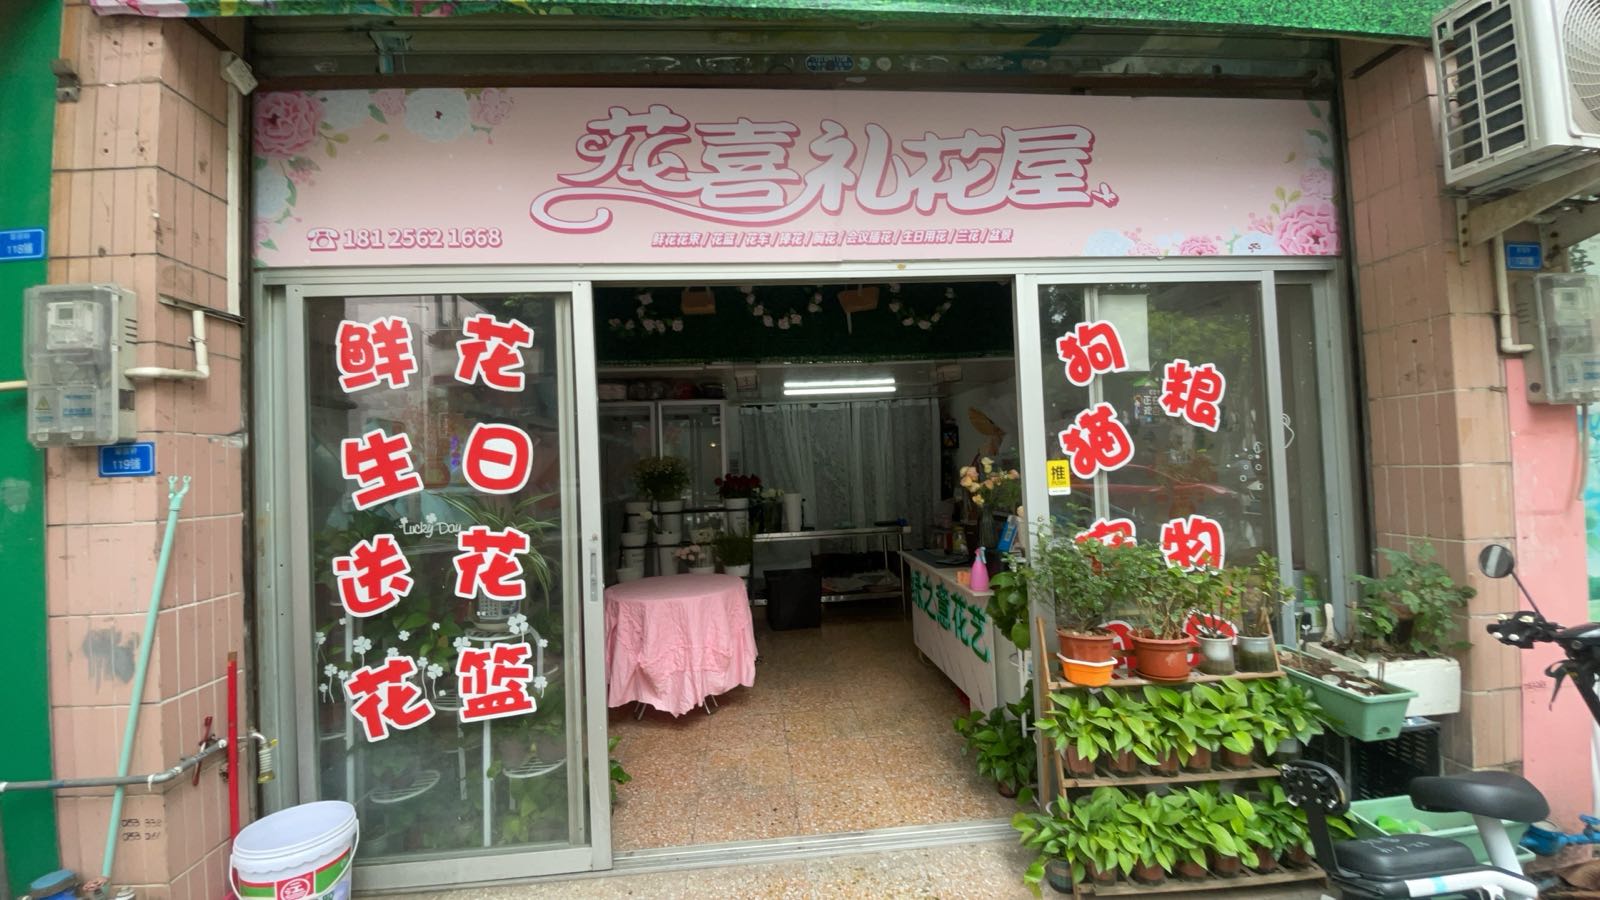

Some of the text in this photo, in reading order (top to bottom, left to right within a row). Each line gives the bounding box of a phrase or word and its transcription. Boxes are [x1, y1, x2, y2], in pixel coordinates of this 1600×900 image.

[531, 104, 1097, 233] 花喜礼花屋
[343, 227, 503, 249] 181 2562 1668
[1051, 465, 1066, 480] 推
[399, 521, 462, 538] Lucky Day
